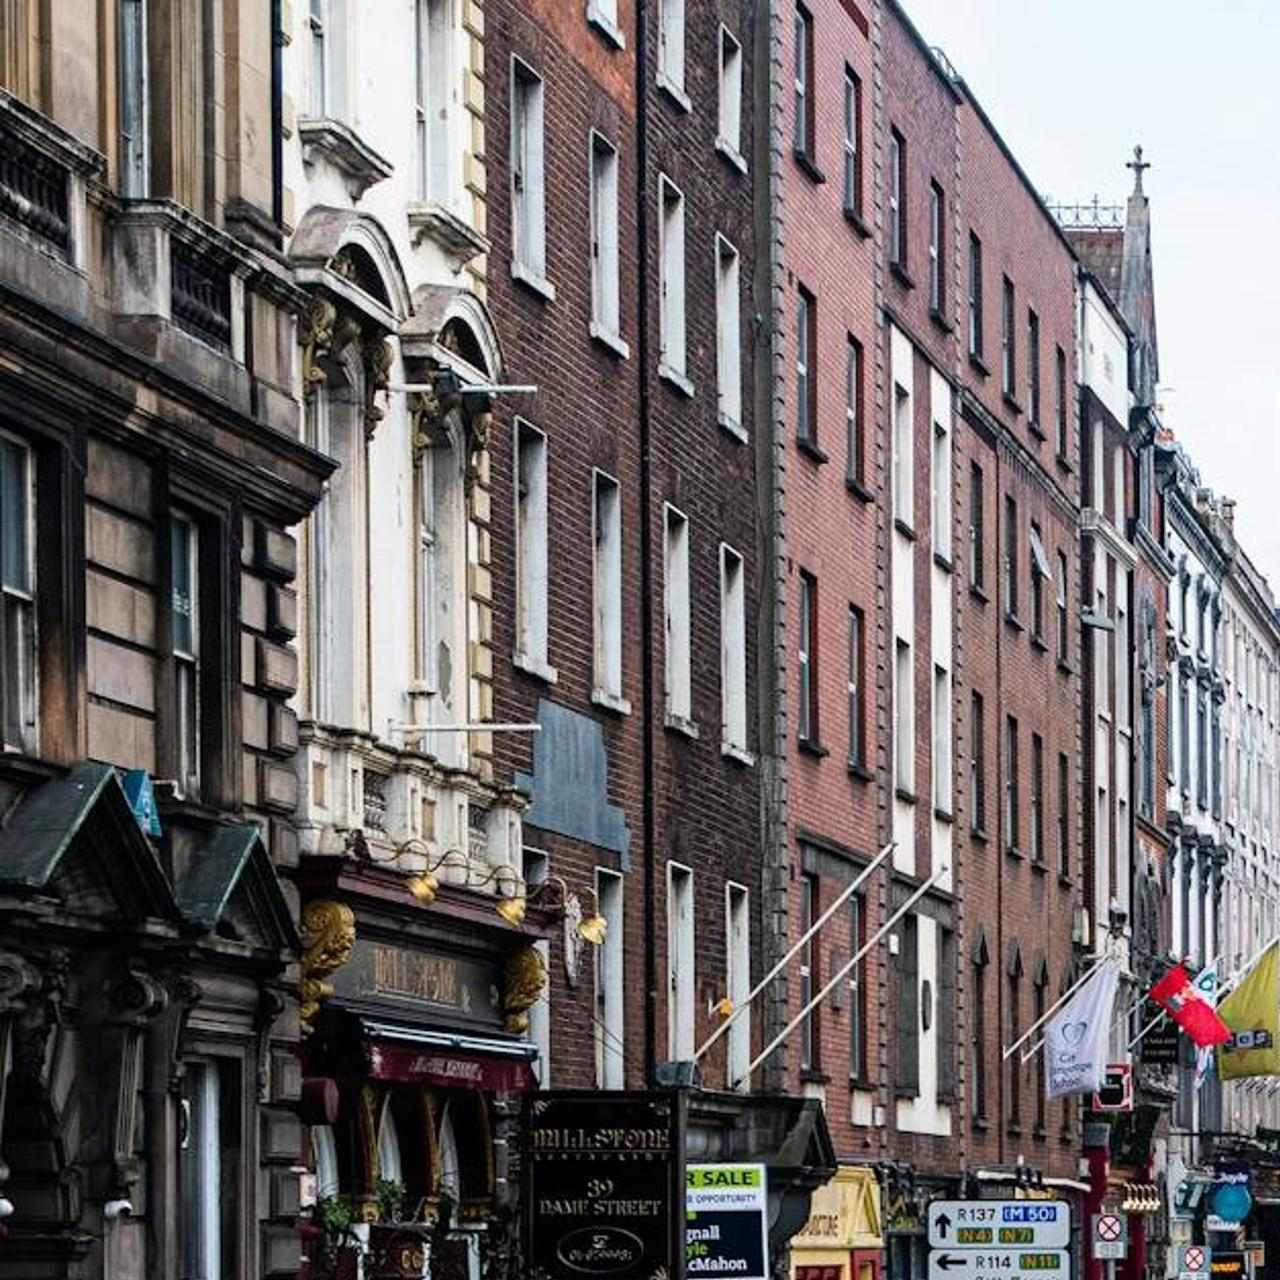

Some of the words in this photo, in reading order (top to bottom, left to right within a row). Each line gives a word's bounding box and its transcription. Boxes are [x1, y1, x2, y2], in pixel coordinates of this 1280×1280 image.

[703, 1171, 753, 1186] SALE
[540, 1200, 588, 1216] DAME
[593, 1200, 662, 1216] STREET
[686, 1225, 720, 1243] gnall
[686, 1242, 708, 1259] yle
[687, 1256, 748, 1272] cMahon
